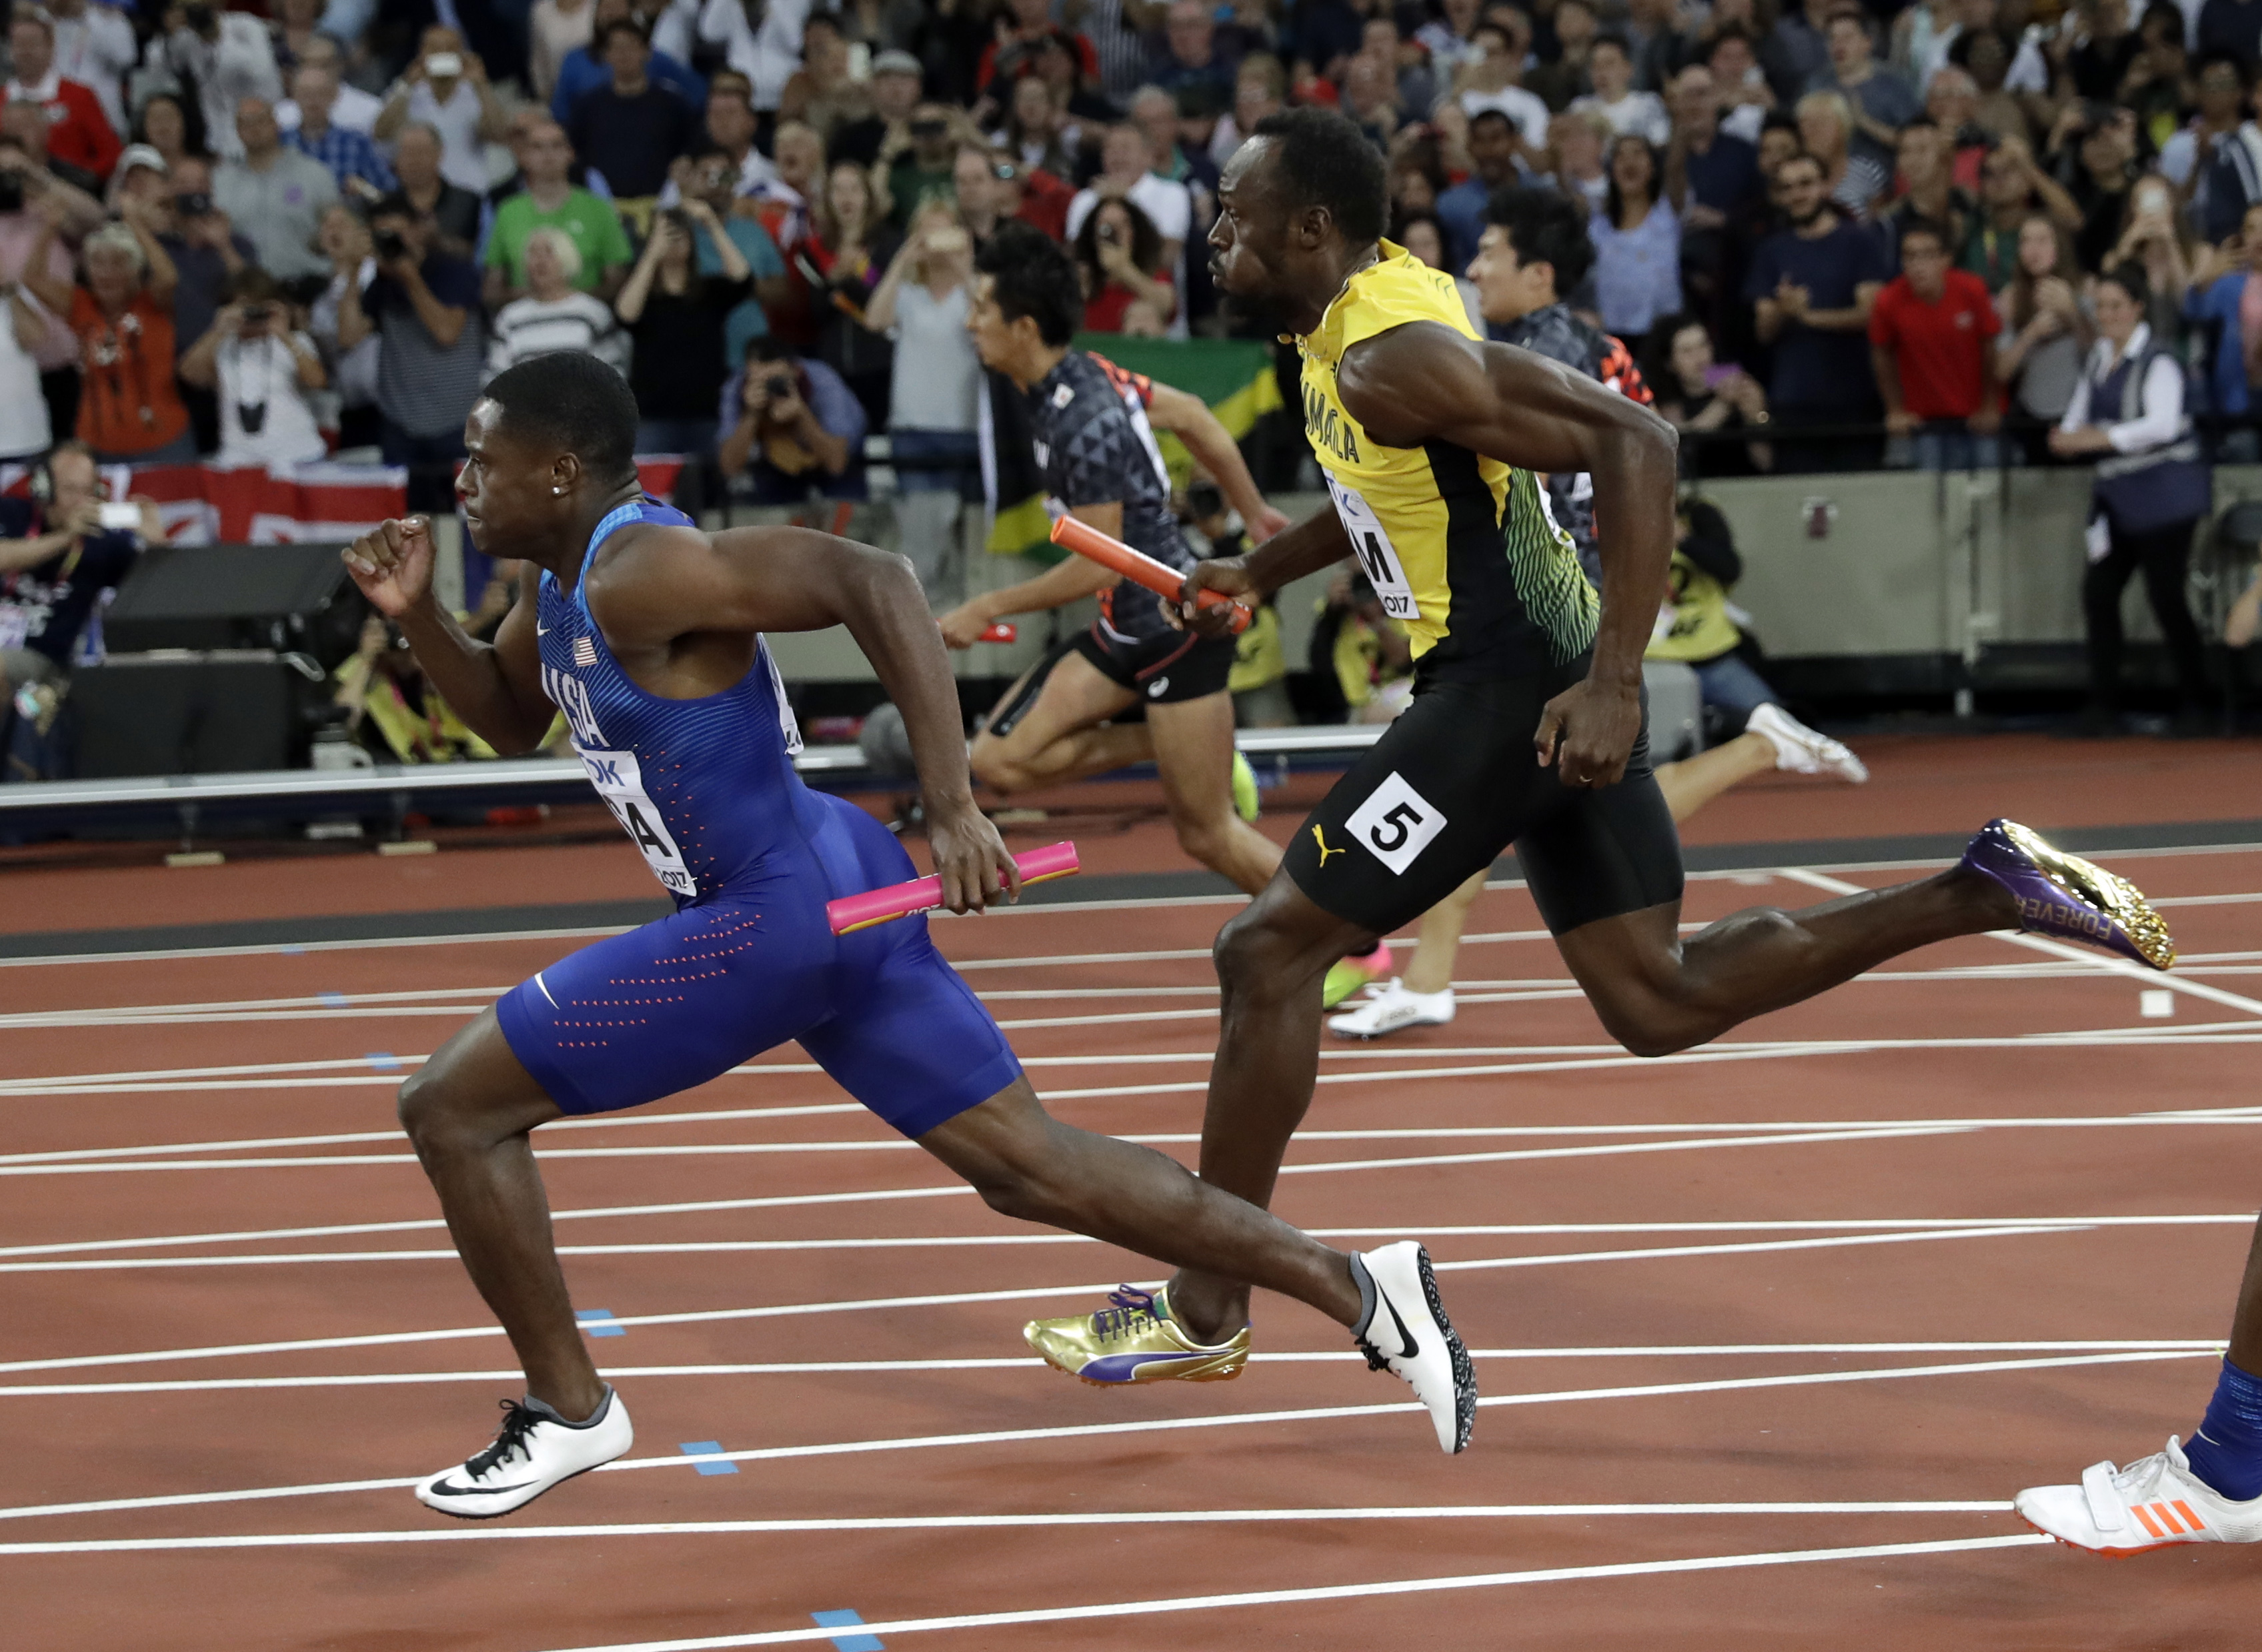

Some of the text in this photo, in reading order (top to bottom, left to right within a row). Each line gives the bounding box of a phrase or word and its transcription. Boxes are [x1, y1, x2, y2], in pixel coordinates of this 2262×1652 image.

[541, 662, 612, 748] USA
[1370, 802, 1424, 852] 5
[2015, 896, 2113, 941] FOREVER
